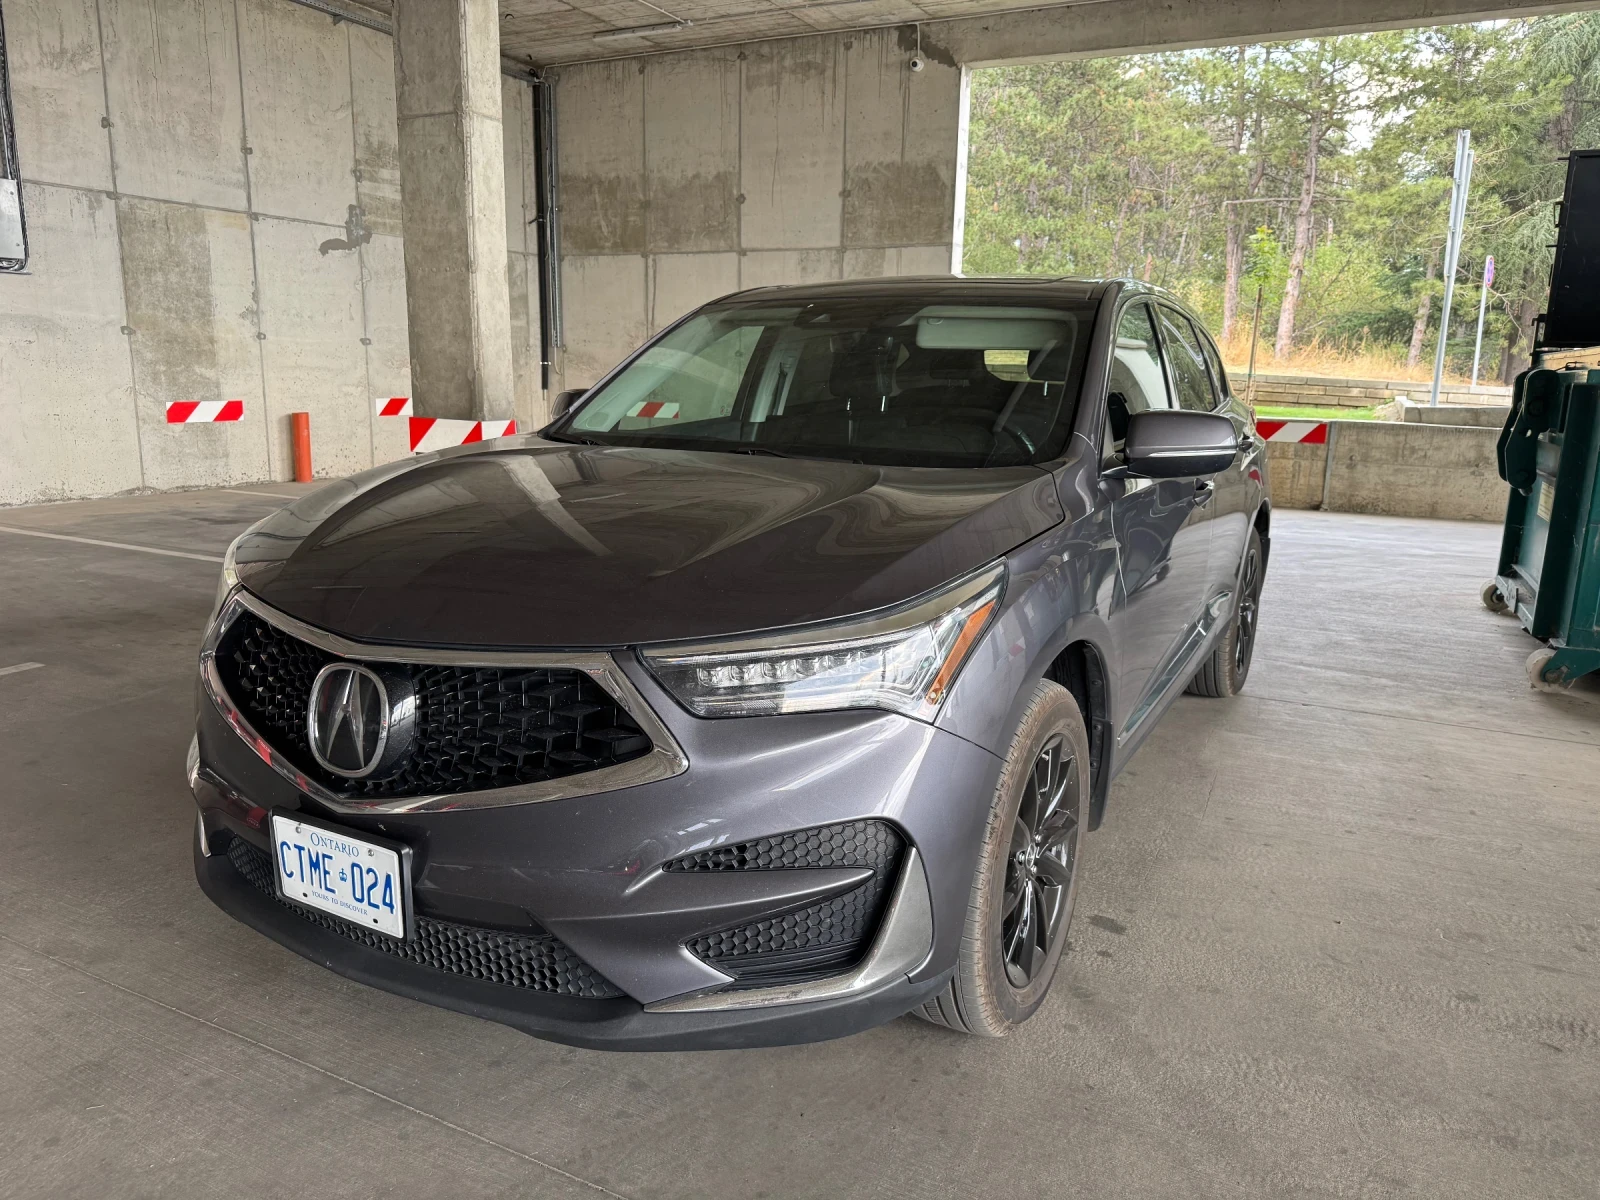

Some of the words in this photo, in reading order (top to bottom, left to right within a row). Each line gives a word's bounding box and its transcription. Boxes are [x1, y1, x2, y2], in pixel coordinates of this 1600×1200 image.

[280, 840, 337, 895] CTME
[350, 862, 395, 915] 024
[311, 890, 330, 902] YOURS
[331, 897, 339, 905] TO
[340, 901, 368, 916] DISCOVER
